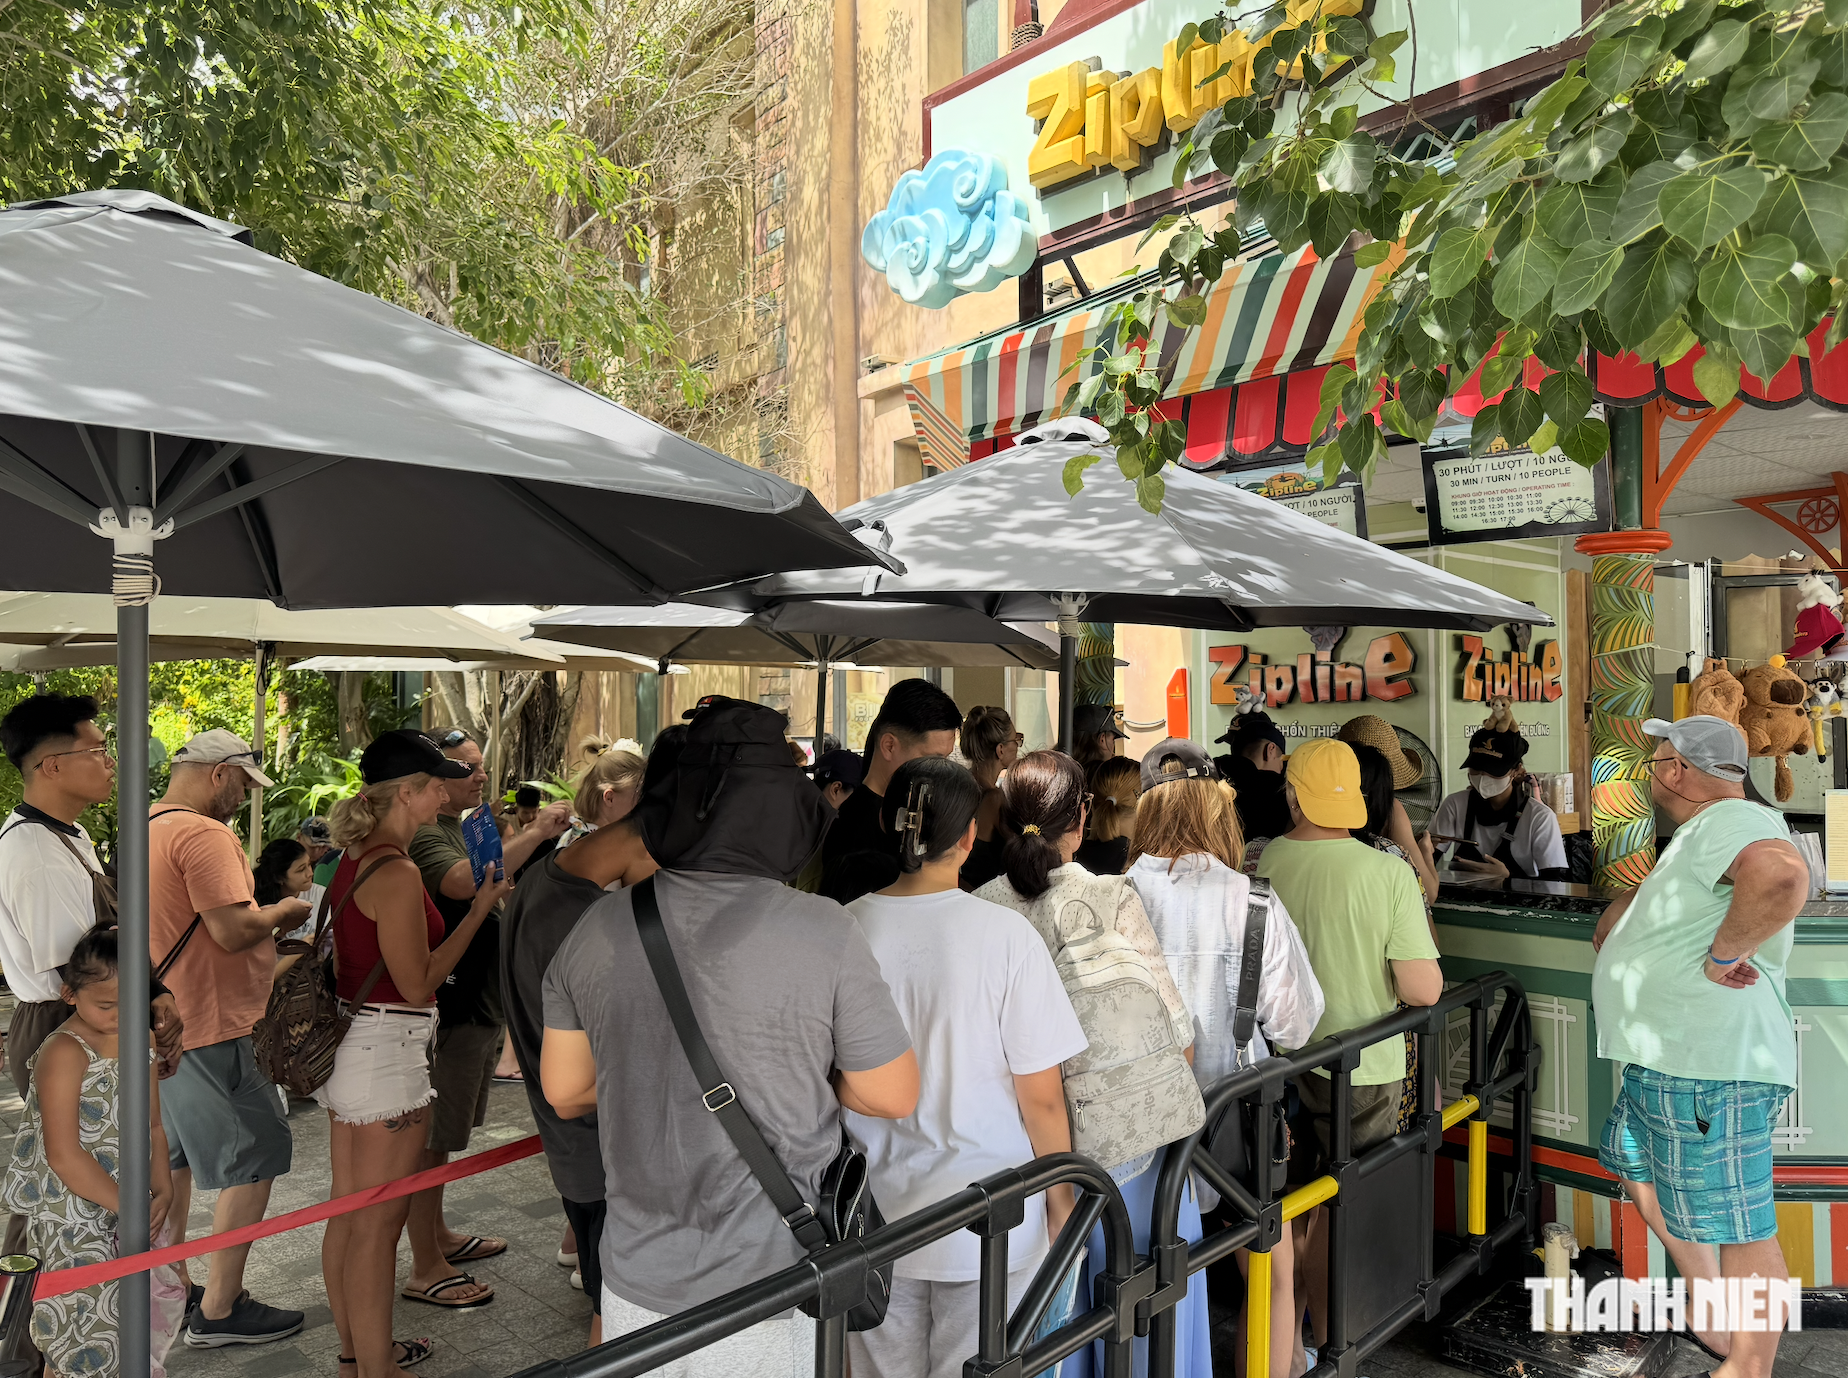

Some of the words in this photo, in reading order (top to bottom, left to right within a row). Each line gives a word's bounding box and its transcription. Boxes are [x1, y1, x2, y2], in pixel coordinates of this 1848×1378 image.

[1438, 468, 1450, 477] 30
[1453, 463, 1482, 475] PHÚT
[1491, 459, 1523, 471] LƯỢT
[1533, 456, 1545, 466] 10
[1450, 480, 1460, 488] 30
[1462, 478, 1479, 486] MIN
[1486, 473, 1511, 483] TURN
[1519, 471, 1530, 480] 10
[1532, 467, 1571, 478] PEOPLE
[1521, 483, 1555, 492] OPERATING
[1257, 480, 1317, 498] Zipline
[1307, 508, 1339, 518] PEOPLE
[1308, 499, 1318, 508] 10
[1208, 631, 1416, 708] Zipline
[1461, 633, 1564, 704] Zipline
[1245, 928, 1260, 981] PRADA
